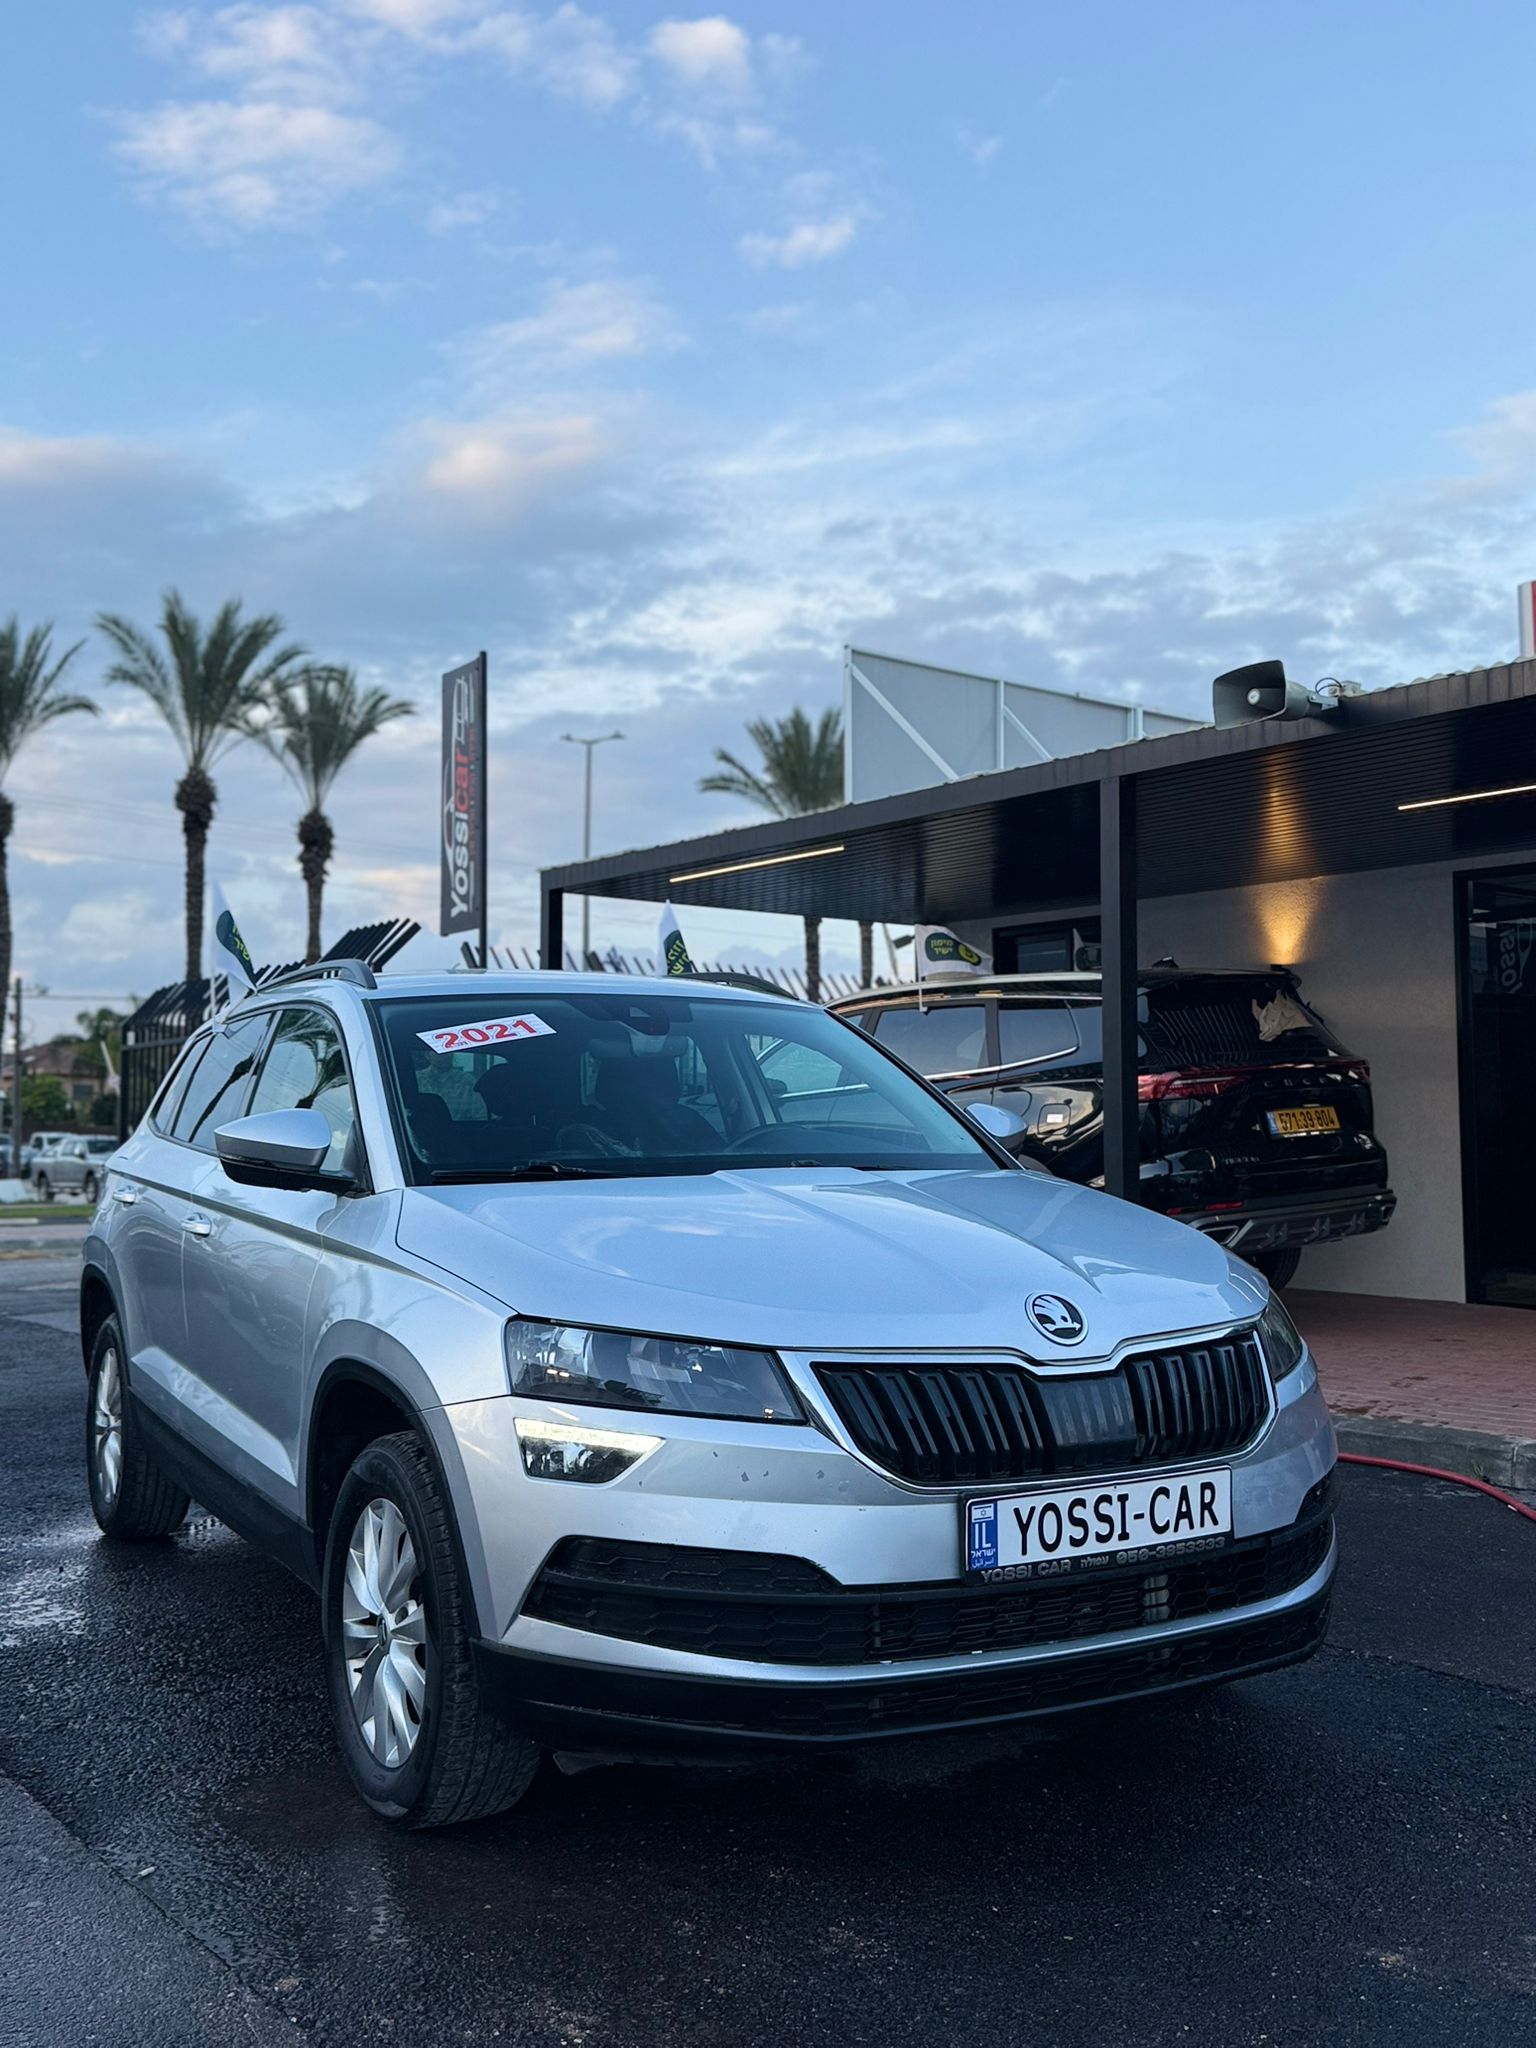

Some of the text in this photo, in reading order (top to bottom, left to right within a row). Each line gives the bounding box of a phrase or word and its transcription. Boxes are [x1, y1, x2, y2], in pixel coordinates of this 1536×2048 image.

[931, 938, 954, 948] מימון
[934, 947, 953, 955] ישיר
[434, 1019, 537, 1049] 2021
[1013, 1481, 1219, 1556] YOSSI-CAR
[974, 1522, 992, 1550] IL
[971, 1548, 997, 1559] ישראל
[980, 1565, 1033, 1584] YOSSI
[1038, 1559, 1072, 1577] CAR
